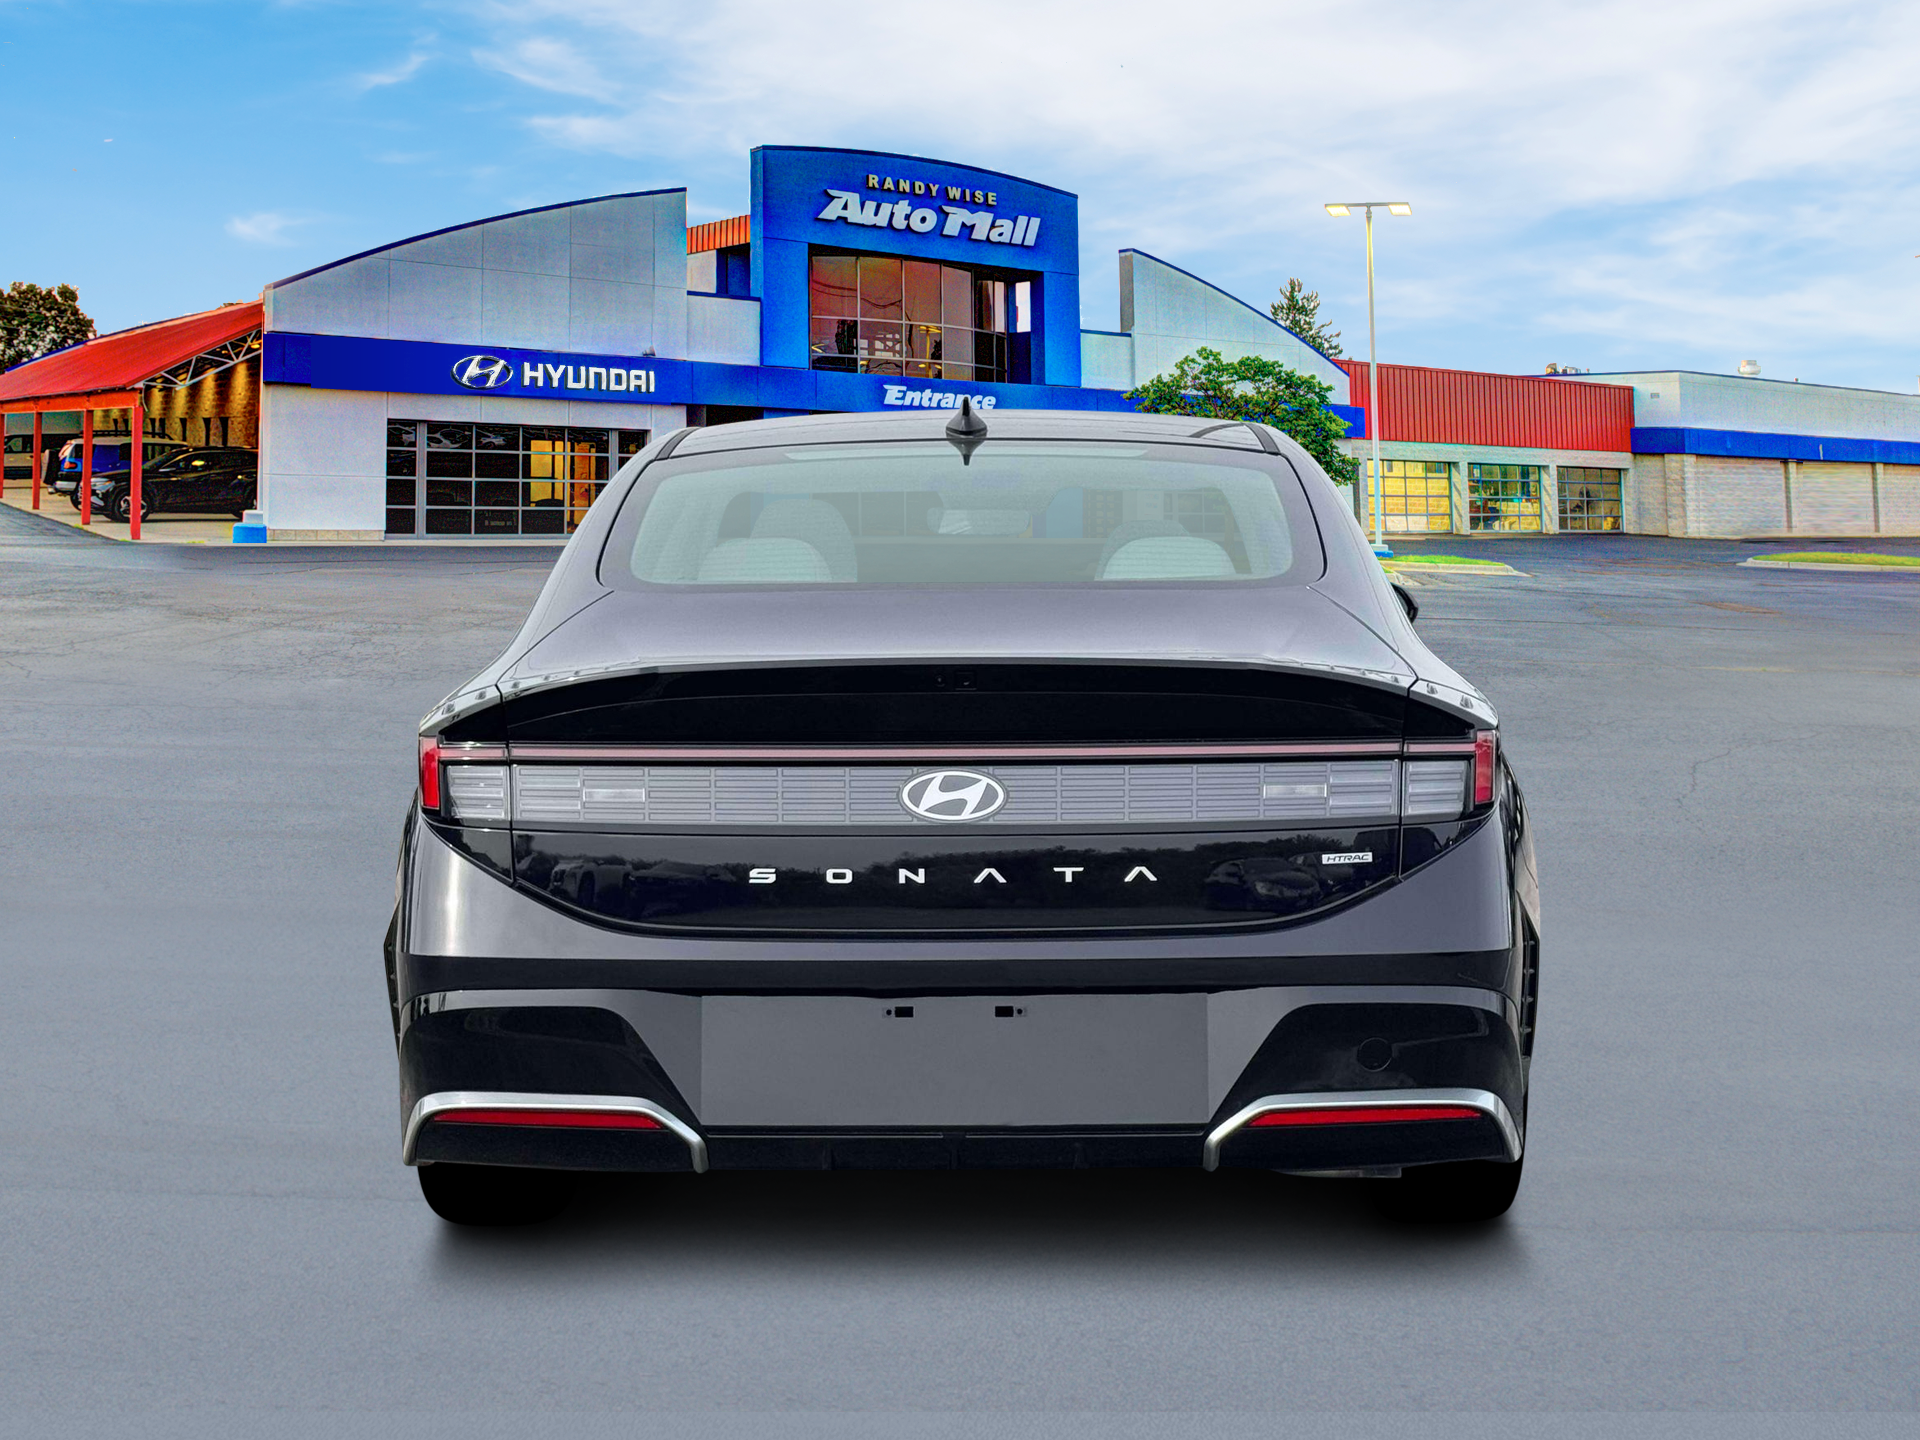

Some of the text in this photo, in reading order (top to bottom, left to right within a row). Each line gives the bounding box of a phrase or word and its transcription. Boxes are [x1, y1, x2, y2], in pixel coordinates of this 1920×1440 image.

[867, 174, 998, 206] RANDY WISE
[818, 189, 1041, 246] Auto Mall
[522, 362, 656, 393] HYUNDAI
[1325, 852, 1371, 863] HTRAC
[748, 866, 1157, 882] SONATA
